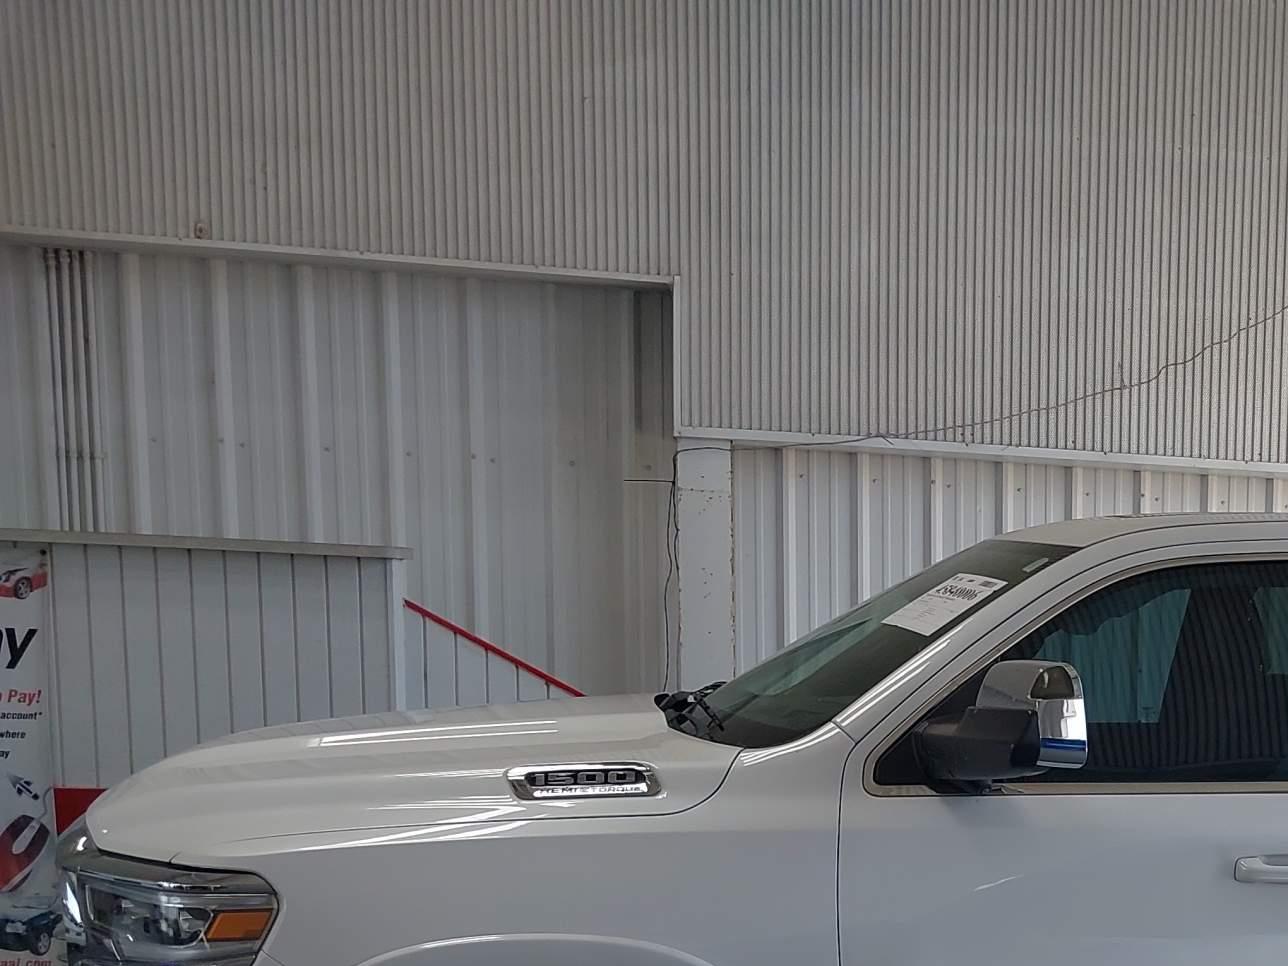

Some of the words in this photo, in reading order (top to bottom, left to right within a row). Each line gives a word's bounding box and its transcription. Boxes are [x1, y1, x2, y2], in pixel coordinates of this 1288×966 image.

[0, 627, 39, 669] y
[7, 689, 42, 706] Pay!
[532, 770, 636, 786] 1500
